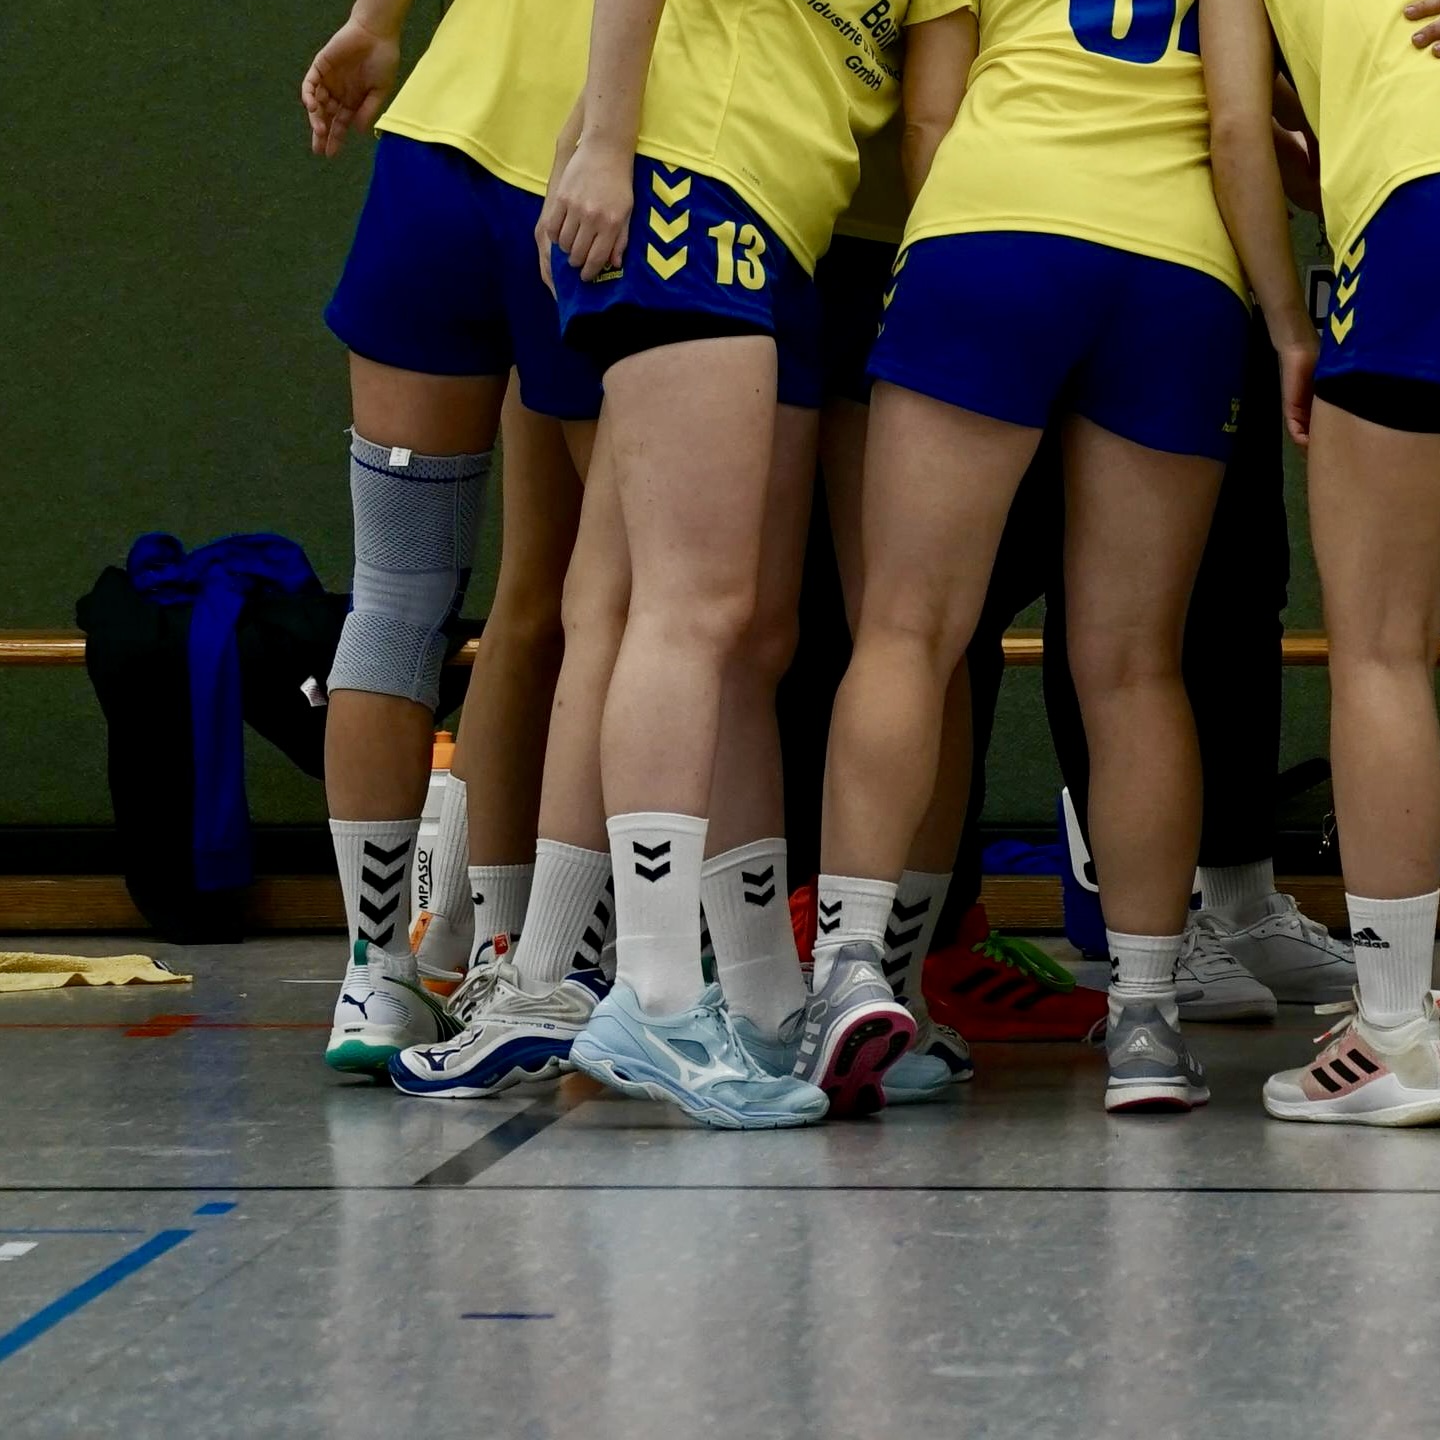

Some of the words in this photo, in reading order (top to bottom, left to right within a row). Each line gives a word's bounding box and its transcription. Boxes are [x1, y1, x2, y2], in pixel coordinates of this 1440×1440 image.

[845, 55, 884, 92] GmbH
[707, 220, 767, 291] 13
[418, 850, 429, 909] MPASO
